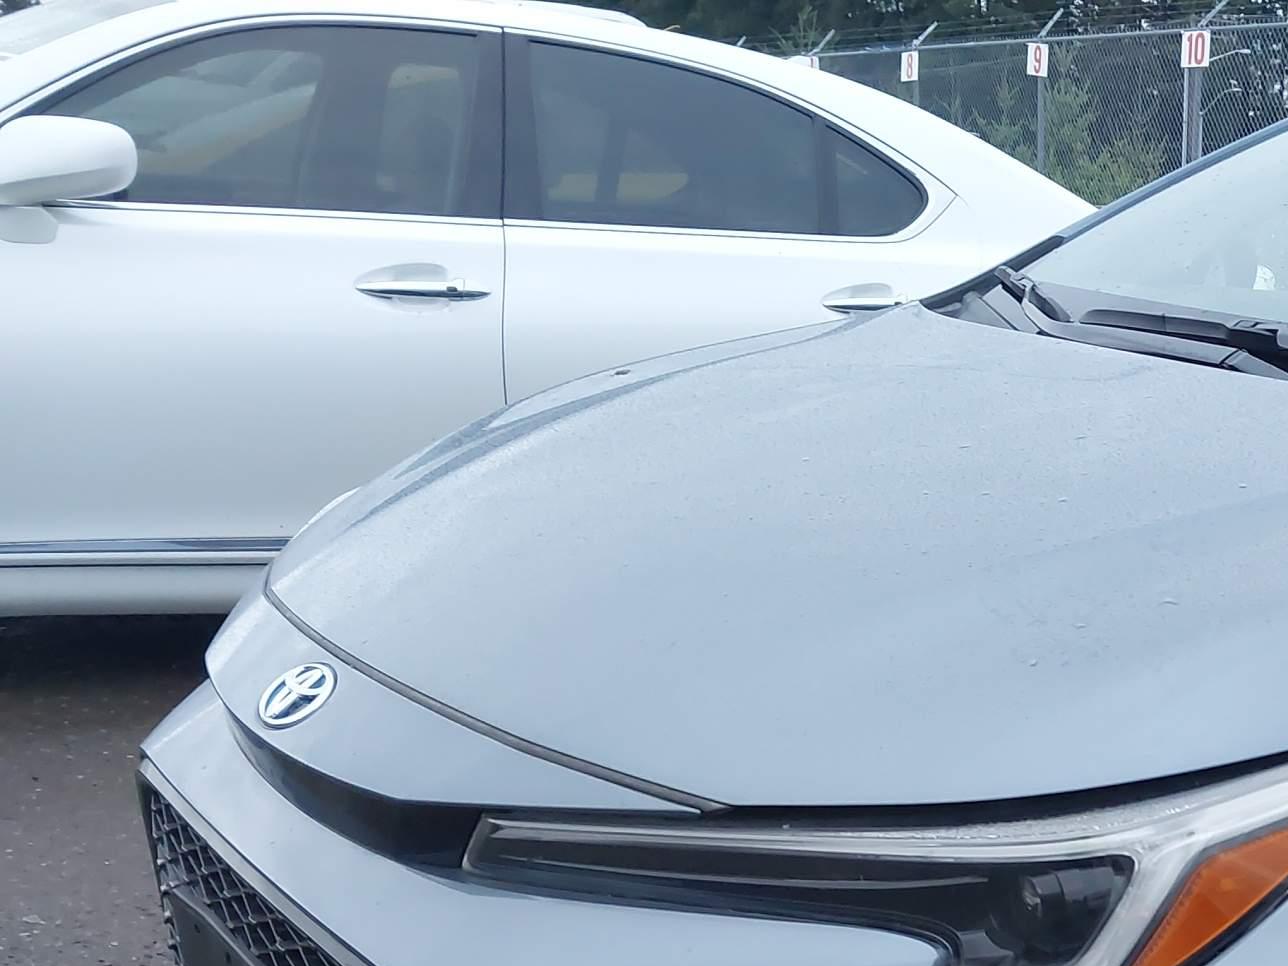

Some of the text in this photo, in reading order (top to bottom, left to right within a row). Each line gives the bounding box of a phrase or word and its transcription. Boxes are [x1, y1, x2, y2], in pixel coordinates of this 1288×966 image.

[1033, 44, 1043, 74] 9
[1186, 31, 1206, 65] 10
[906, 52, 914, 80] 8
